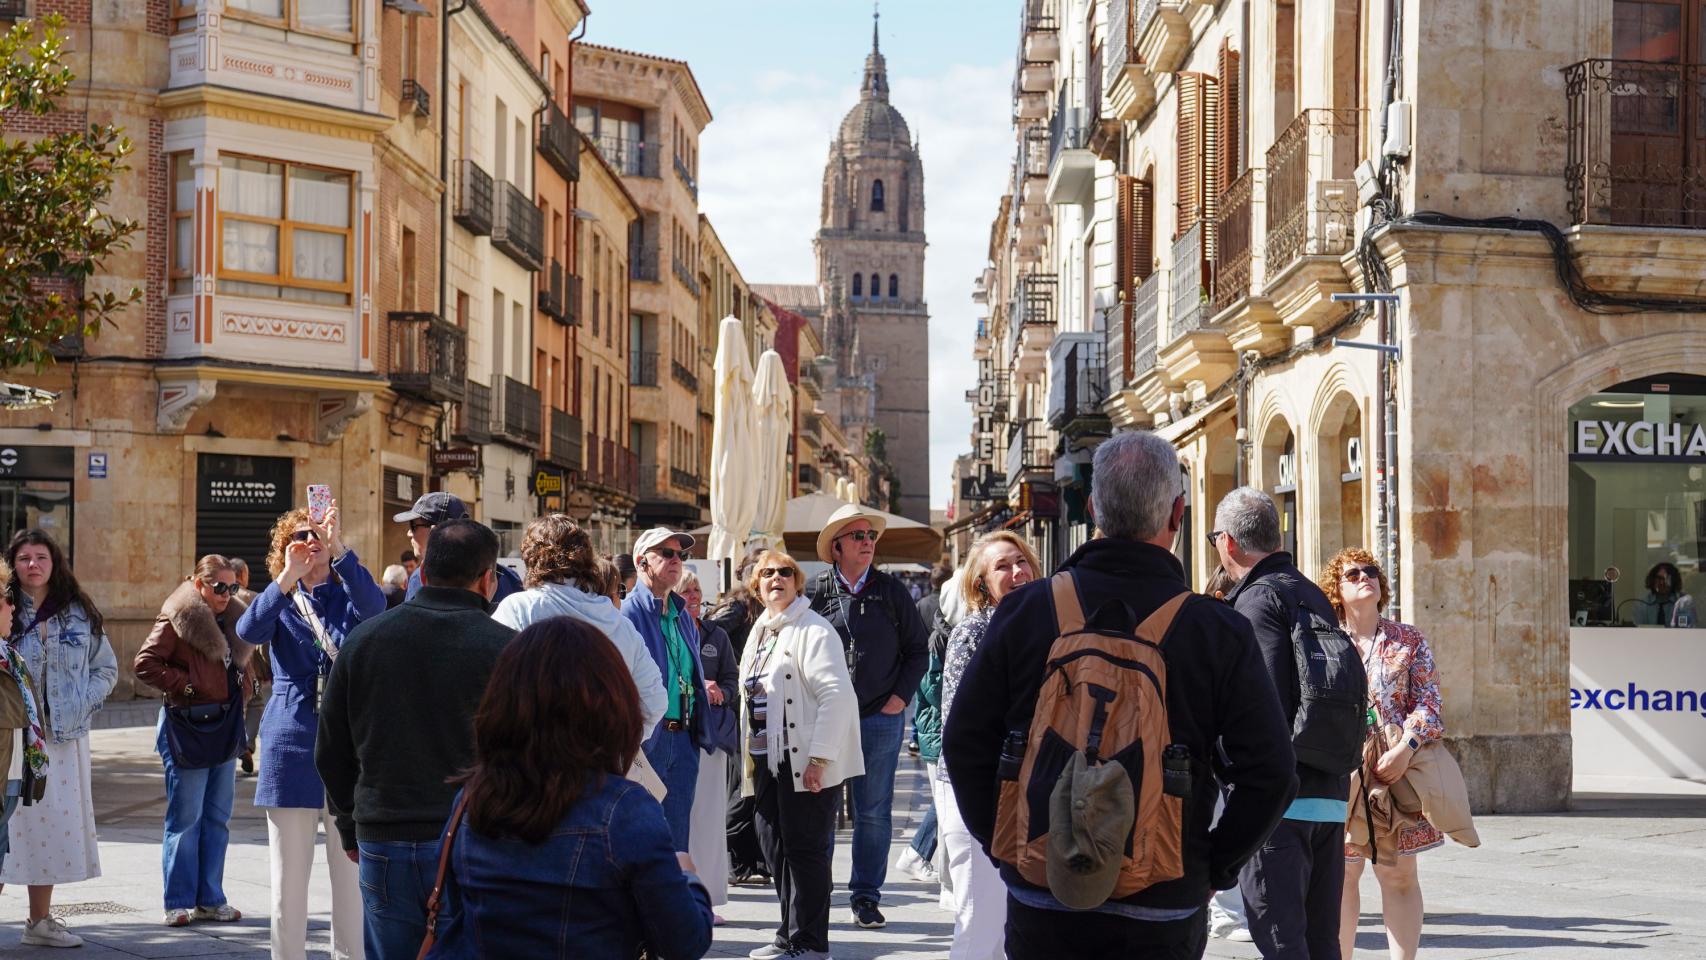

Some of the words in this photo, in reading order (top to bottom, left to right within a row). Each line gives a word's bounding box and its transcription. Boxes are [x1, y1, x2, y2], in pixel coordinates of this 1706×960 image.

[1576, 420, 1706, 456] EXCHA
[210, 481, 276, 497] KUATRO
[1570, 682, 1706, 718] exchan
